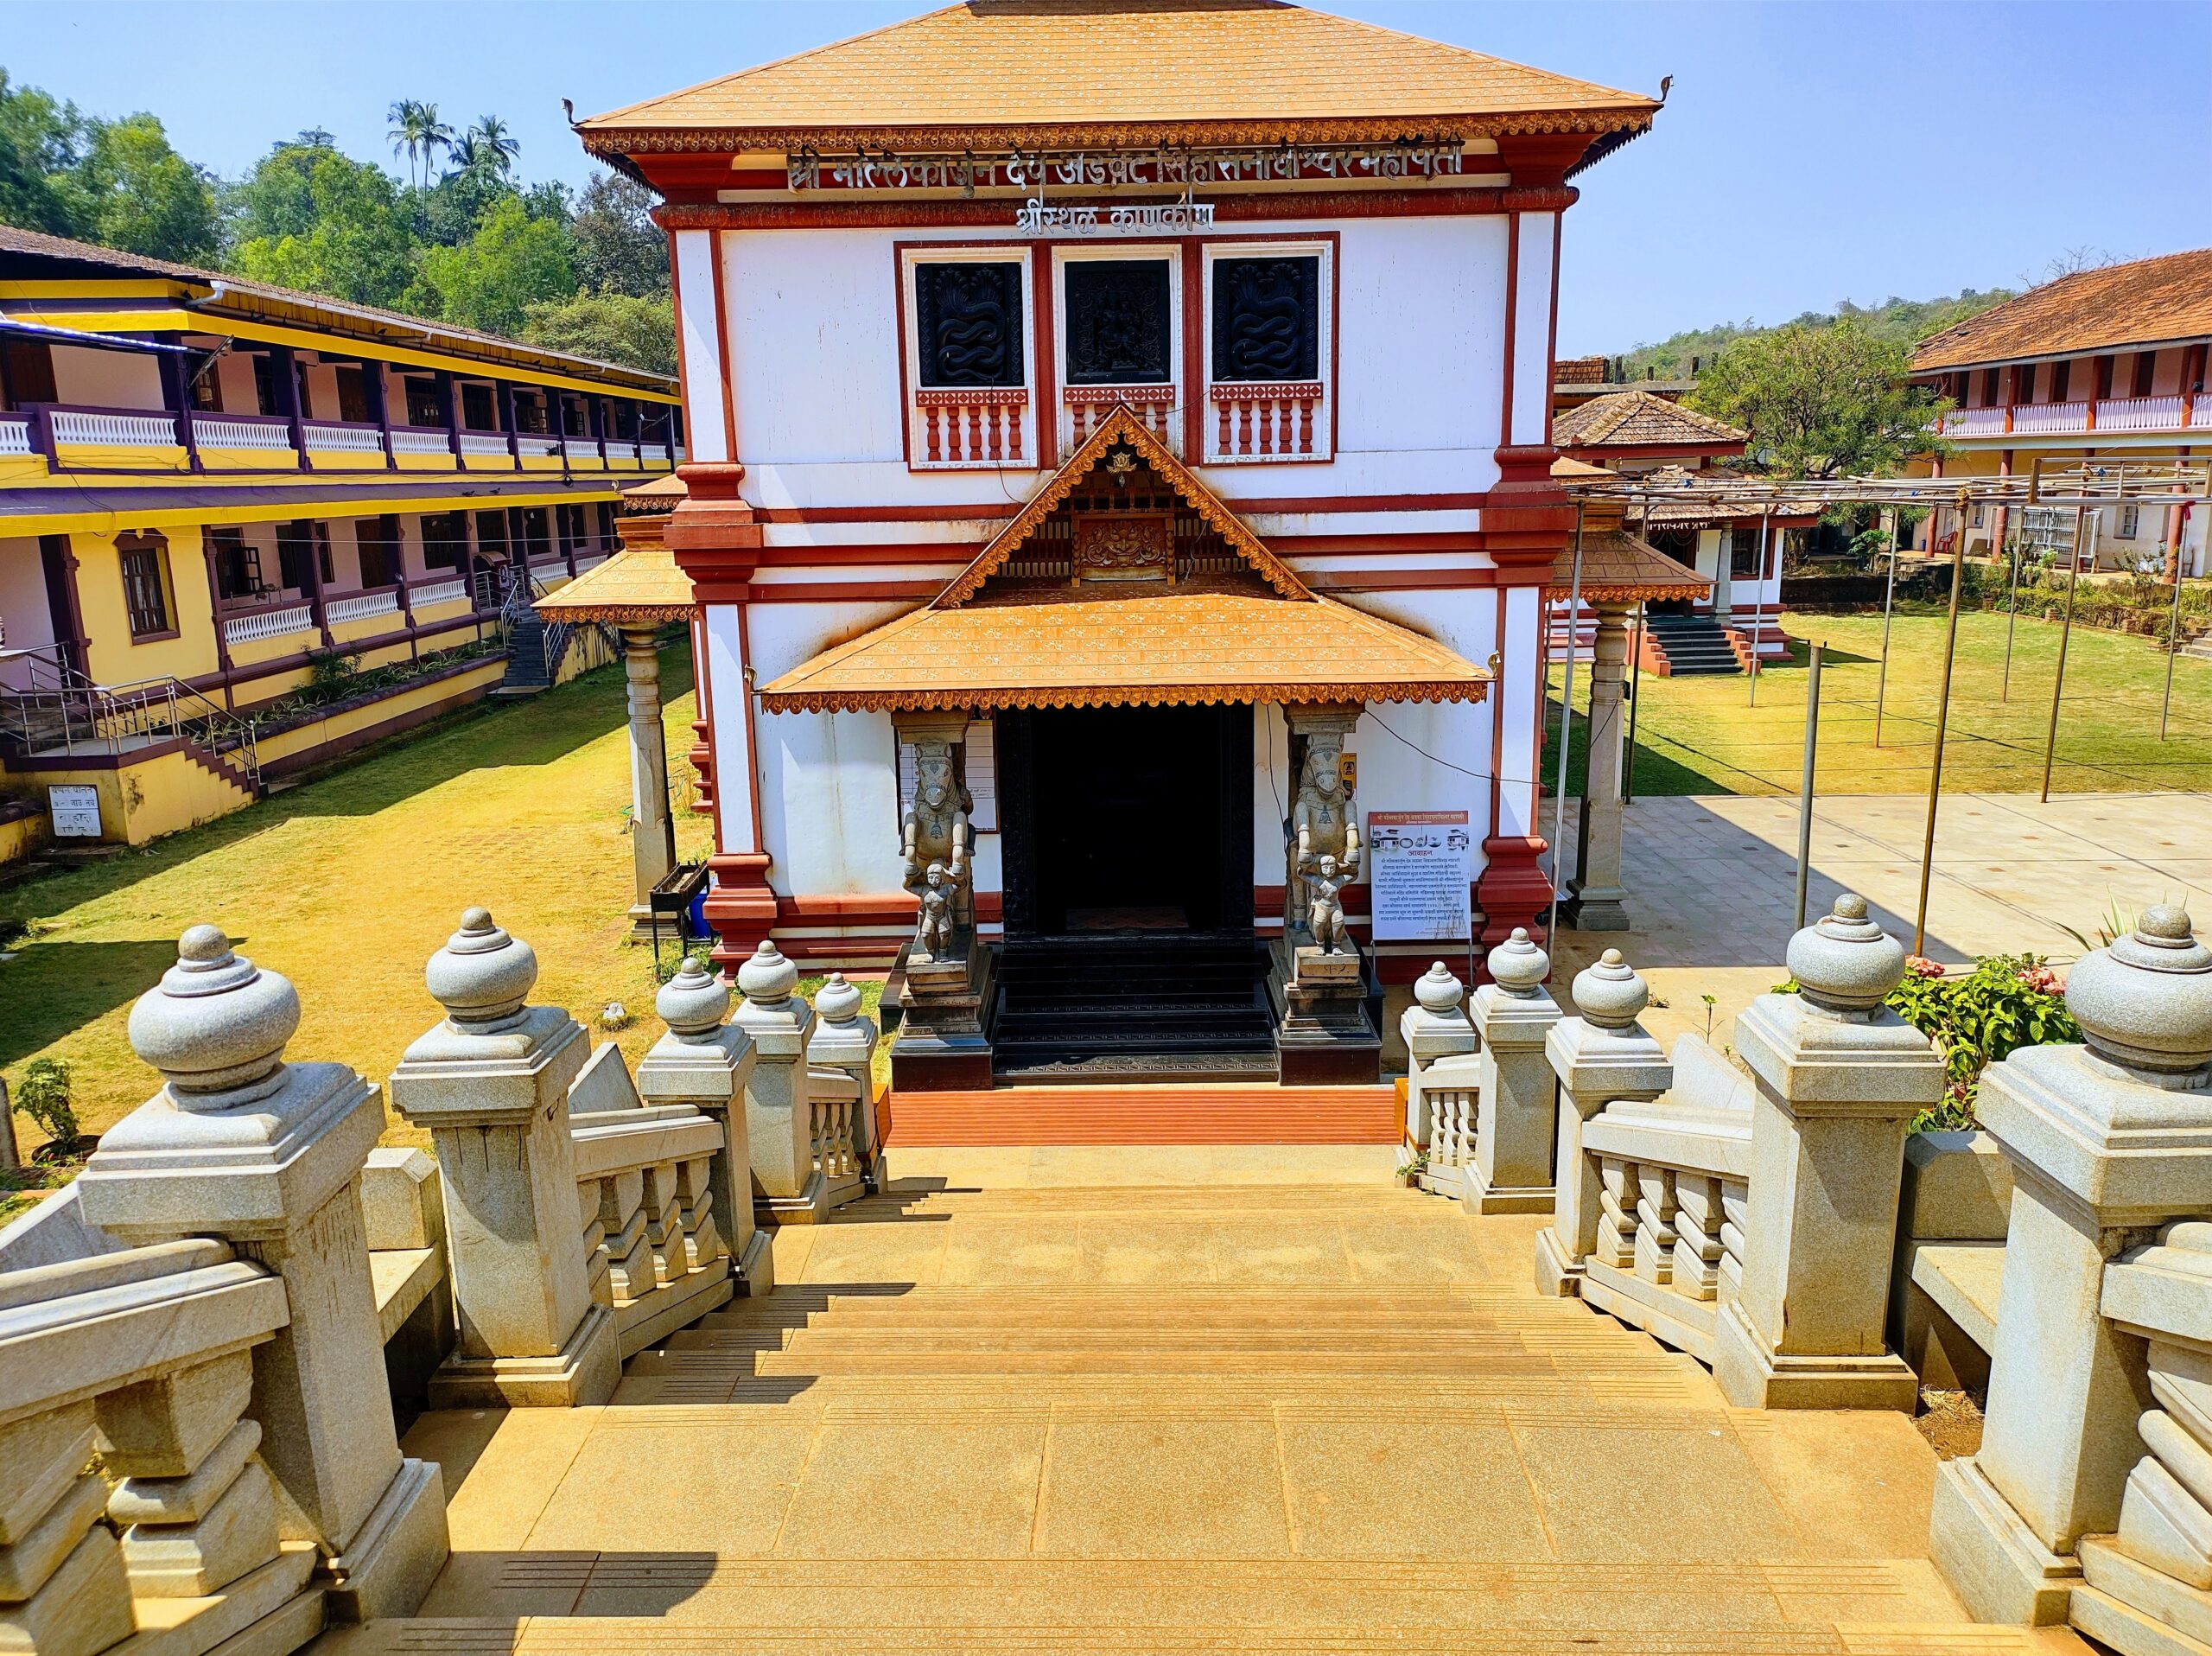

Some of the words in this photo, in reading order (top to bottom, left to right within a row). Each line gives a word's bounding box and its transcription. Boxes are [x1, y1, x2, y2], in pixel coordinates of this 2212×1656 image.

[787, 143, 820, 191] श्री
[1007, 144, 1046, 191] देव
[1015, 198, 1099, 235] श्रीस्थळ
[1110, 191, 1215, 232] काणकोण
